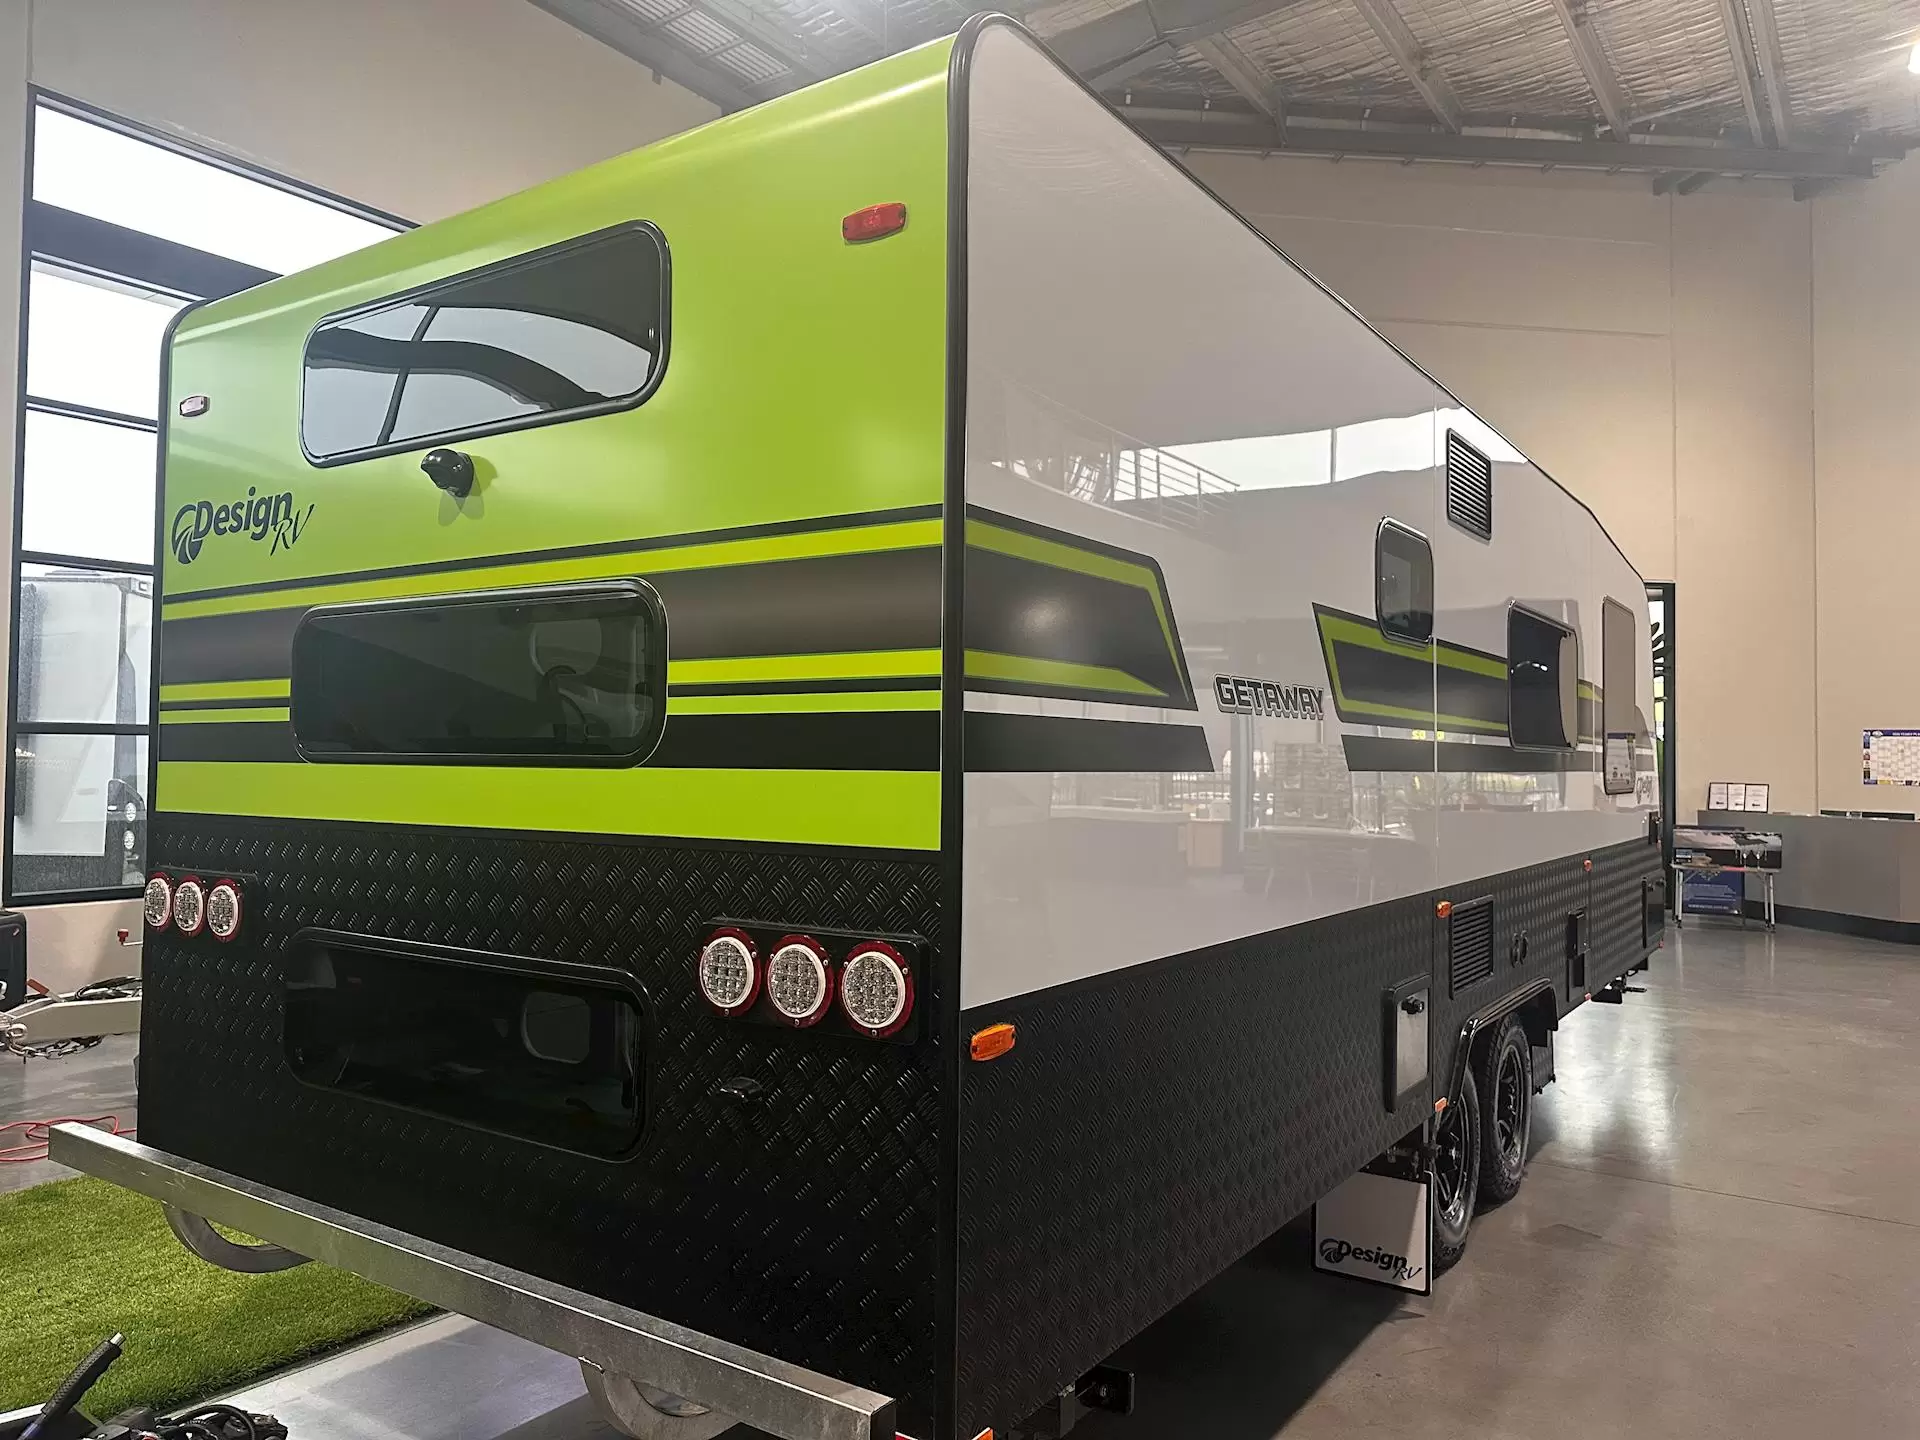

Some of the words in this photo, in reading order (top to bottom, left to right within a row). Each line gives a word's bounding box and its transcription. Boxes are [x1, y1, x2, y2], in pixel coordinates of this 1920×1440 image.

[193, 486, 293, 541] Design
[270, 503, 315, 557] RV
[1213, 673, 1324, 720] GETAWAY
[1338, 1240, 1408, 1271] Design
[1392, 1266, 1423, 1281] RV
